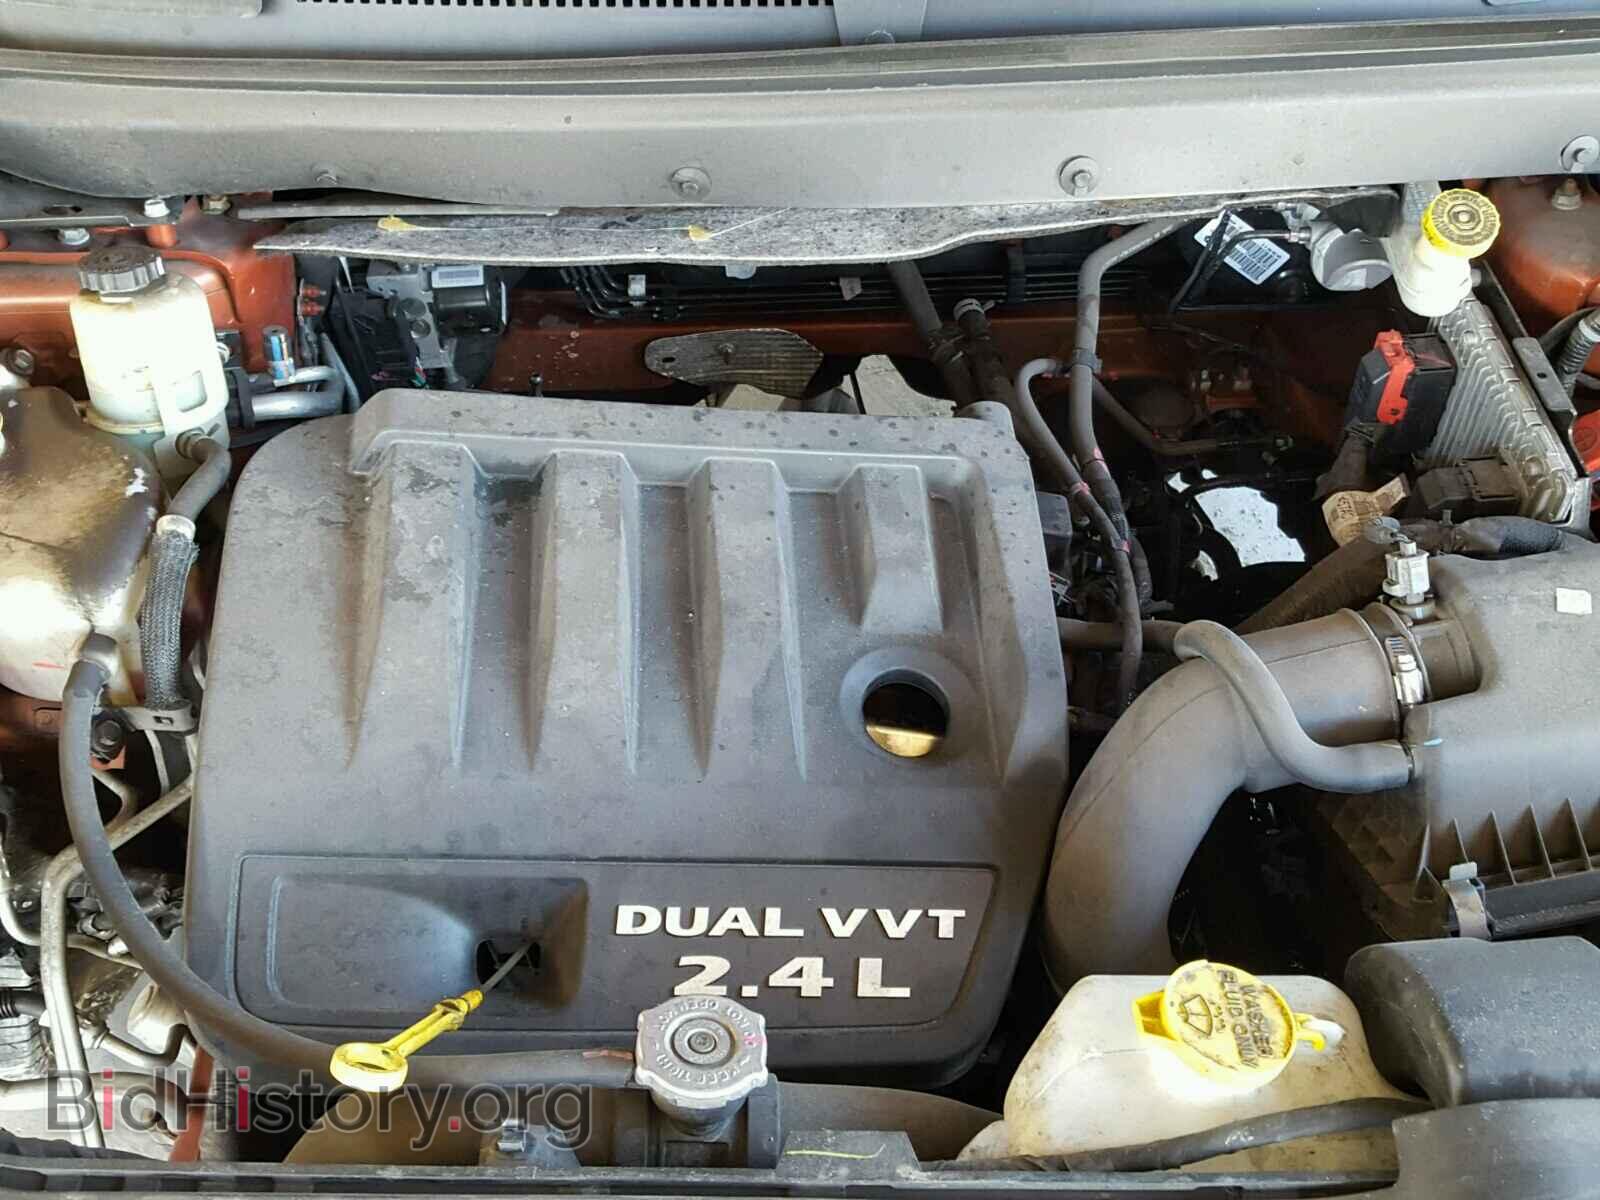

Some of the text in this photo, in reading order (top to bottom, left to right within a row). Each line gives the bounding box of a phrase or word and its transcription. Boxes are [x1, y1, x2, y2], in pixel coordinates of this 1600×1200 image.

[616, 905, 966, 939] DUAL VVT
[1217, 969, 1260, 1068] FLUID ONLY
[1240, 984, 1274, 1058] WASHER
